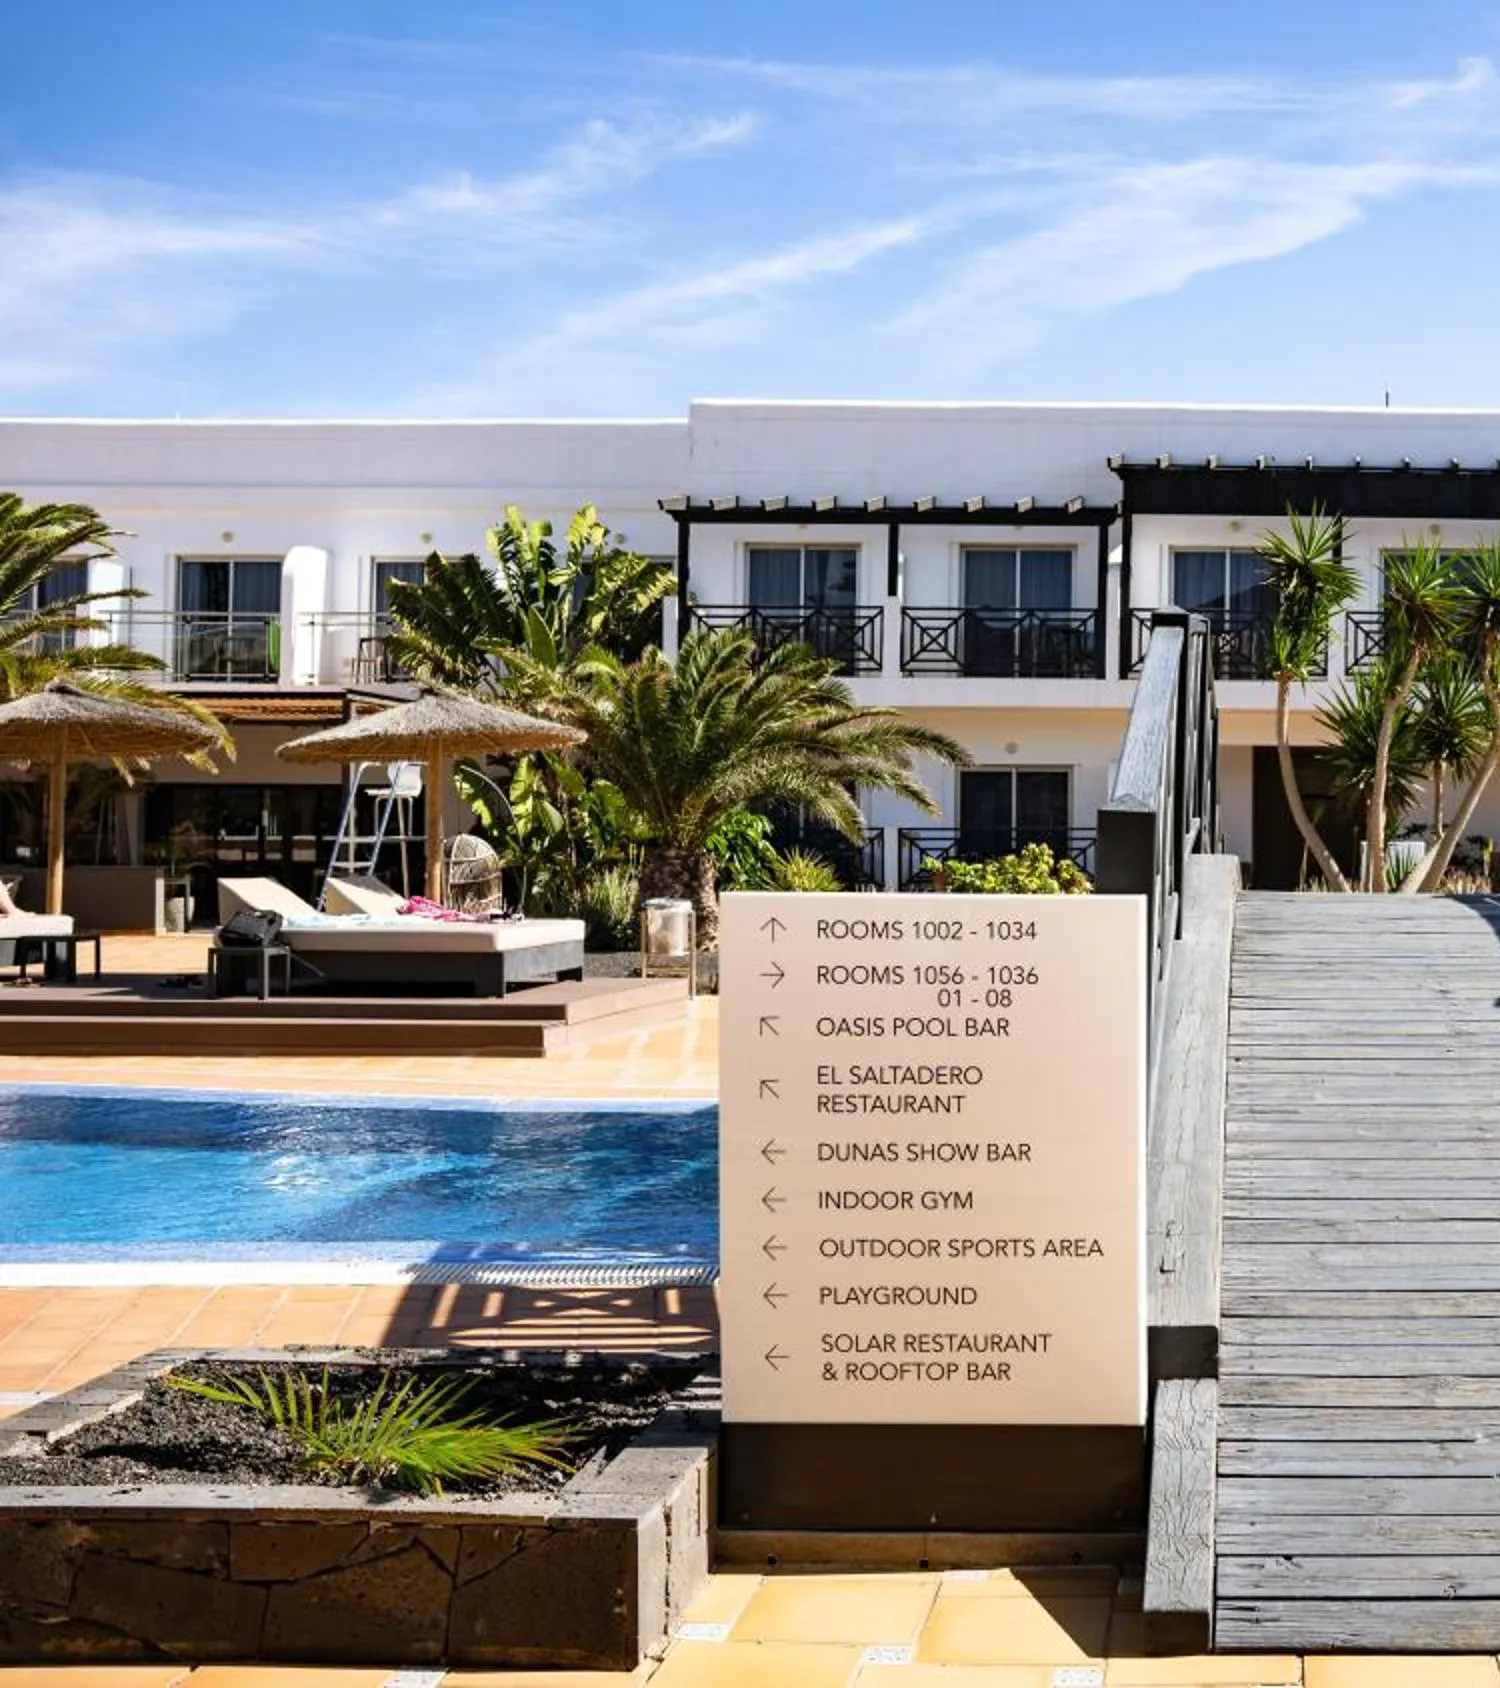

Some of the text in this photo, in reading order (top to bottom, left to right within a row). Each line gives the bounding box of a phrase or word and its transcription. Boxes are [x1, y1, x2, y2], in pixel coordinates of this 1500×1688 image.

[817, 919, 904, 941] ROOMS
[912, 921, 963, 941] 1002
[986, 921, 1037, 941] 1034
[817, 965, 905, 985] ROOMS
[913, 965, 965, 985] 1056
[988, 965, 1039, 985] 1036
[937, 988, 961, 1008] 01
[985, 988, 1013, 1009] 08
[815, 1016, 1010, 1037] OASIS POOL BAR
[817, 1065, 984, 1086] EL SALTADERO
[817, 1093, 966, 1115] RESTAURANT
[817, 1142, 1032, 1163] DUNAS SHOW BAR
[818, 1190, 974, 1211] INDOOR GYM
[818, 1237, 1105, 1259] OUTDOOR SPORTS AREA
[819, 1285, 978, 1306] PLAYGROUND
[820, 1333, 1053, 1354] SOLAR RESTAURANT
[821, 1361, 1012, 1382] & ROOFTOP BAR
